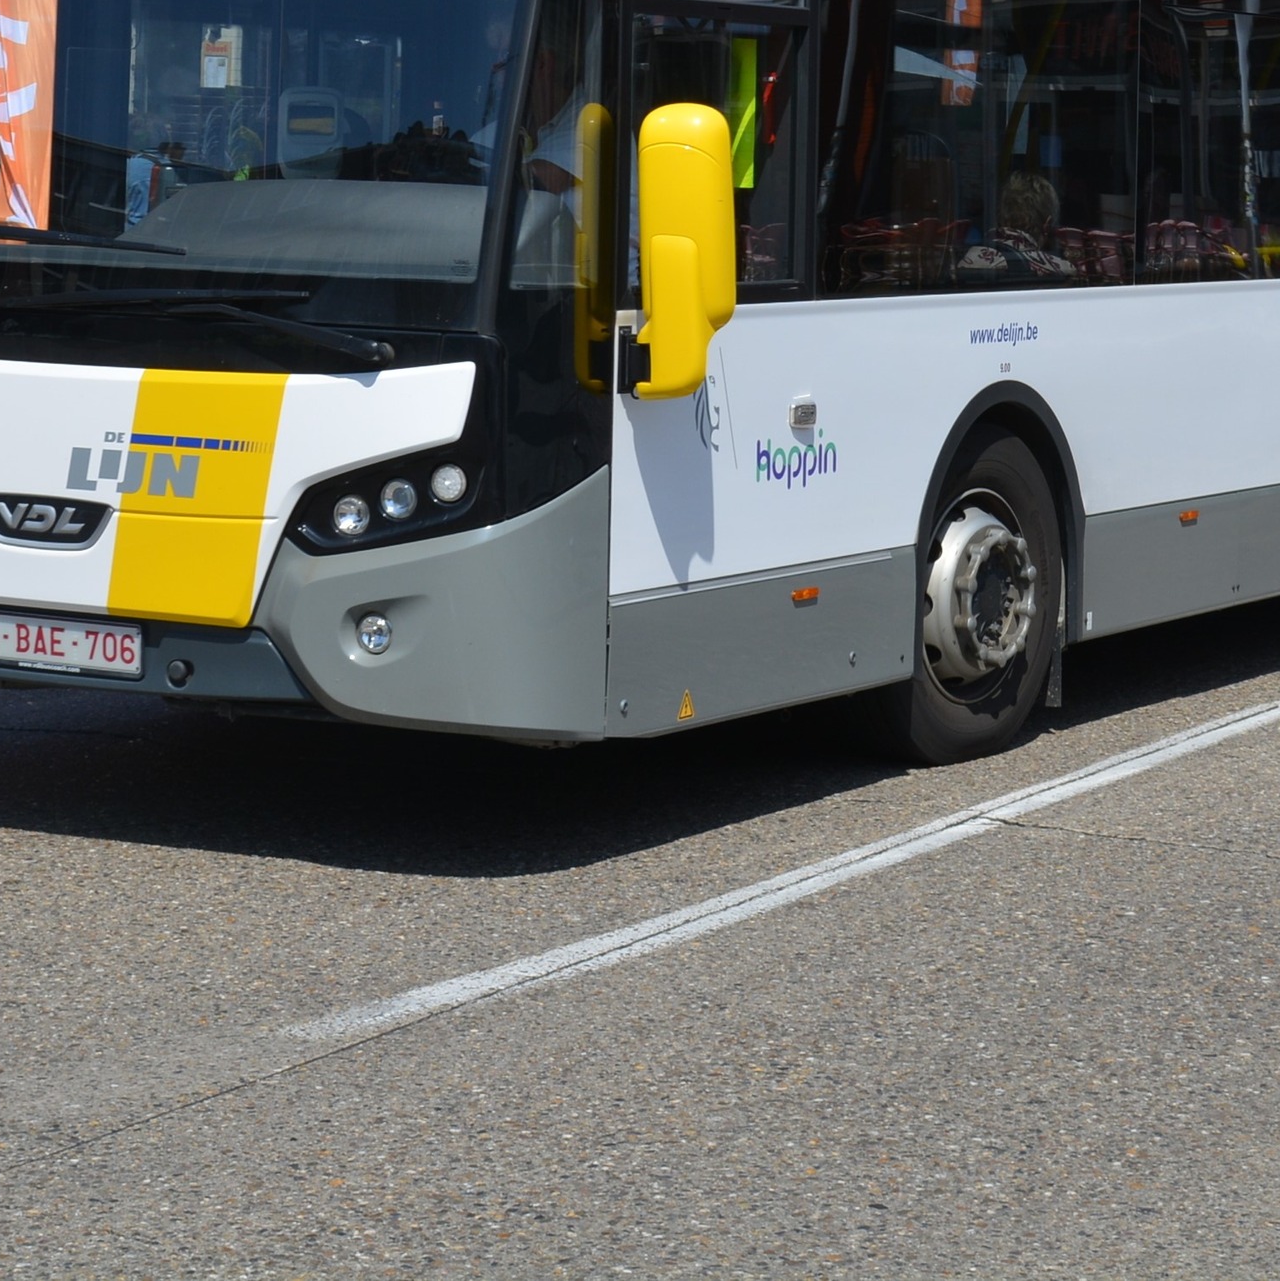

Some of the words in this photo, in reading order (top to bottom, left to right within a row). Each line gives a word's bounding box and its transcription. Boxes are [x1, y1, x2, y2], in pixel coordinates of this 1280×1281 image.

[969, 321, 1038, 347] www.delijn.be
[103, 431, 126, 443] DE
[65, 446, 201, 499] LIJN
